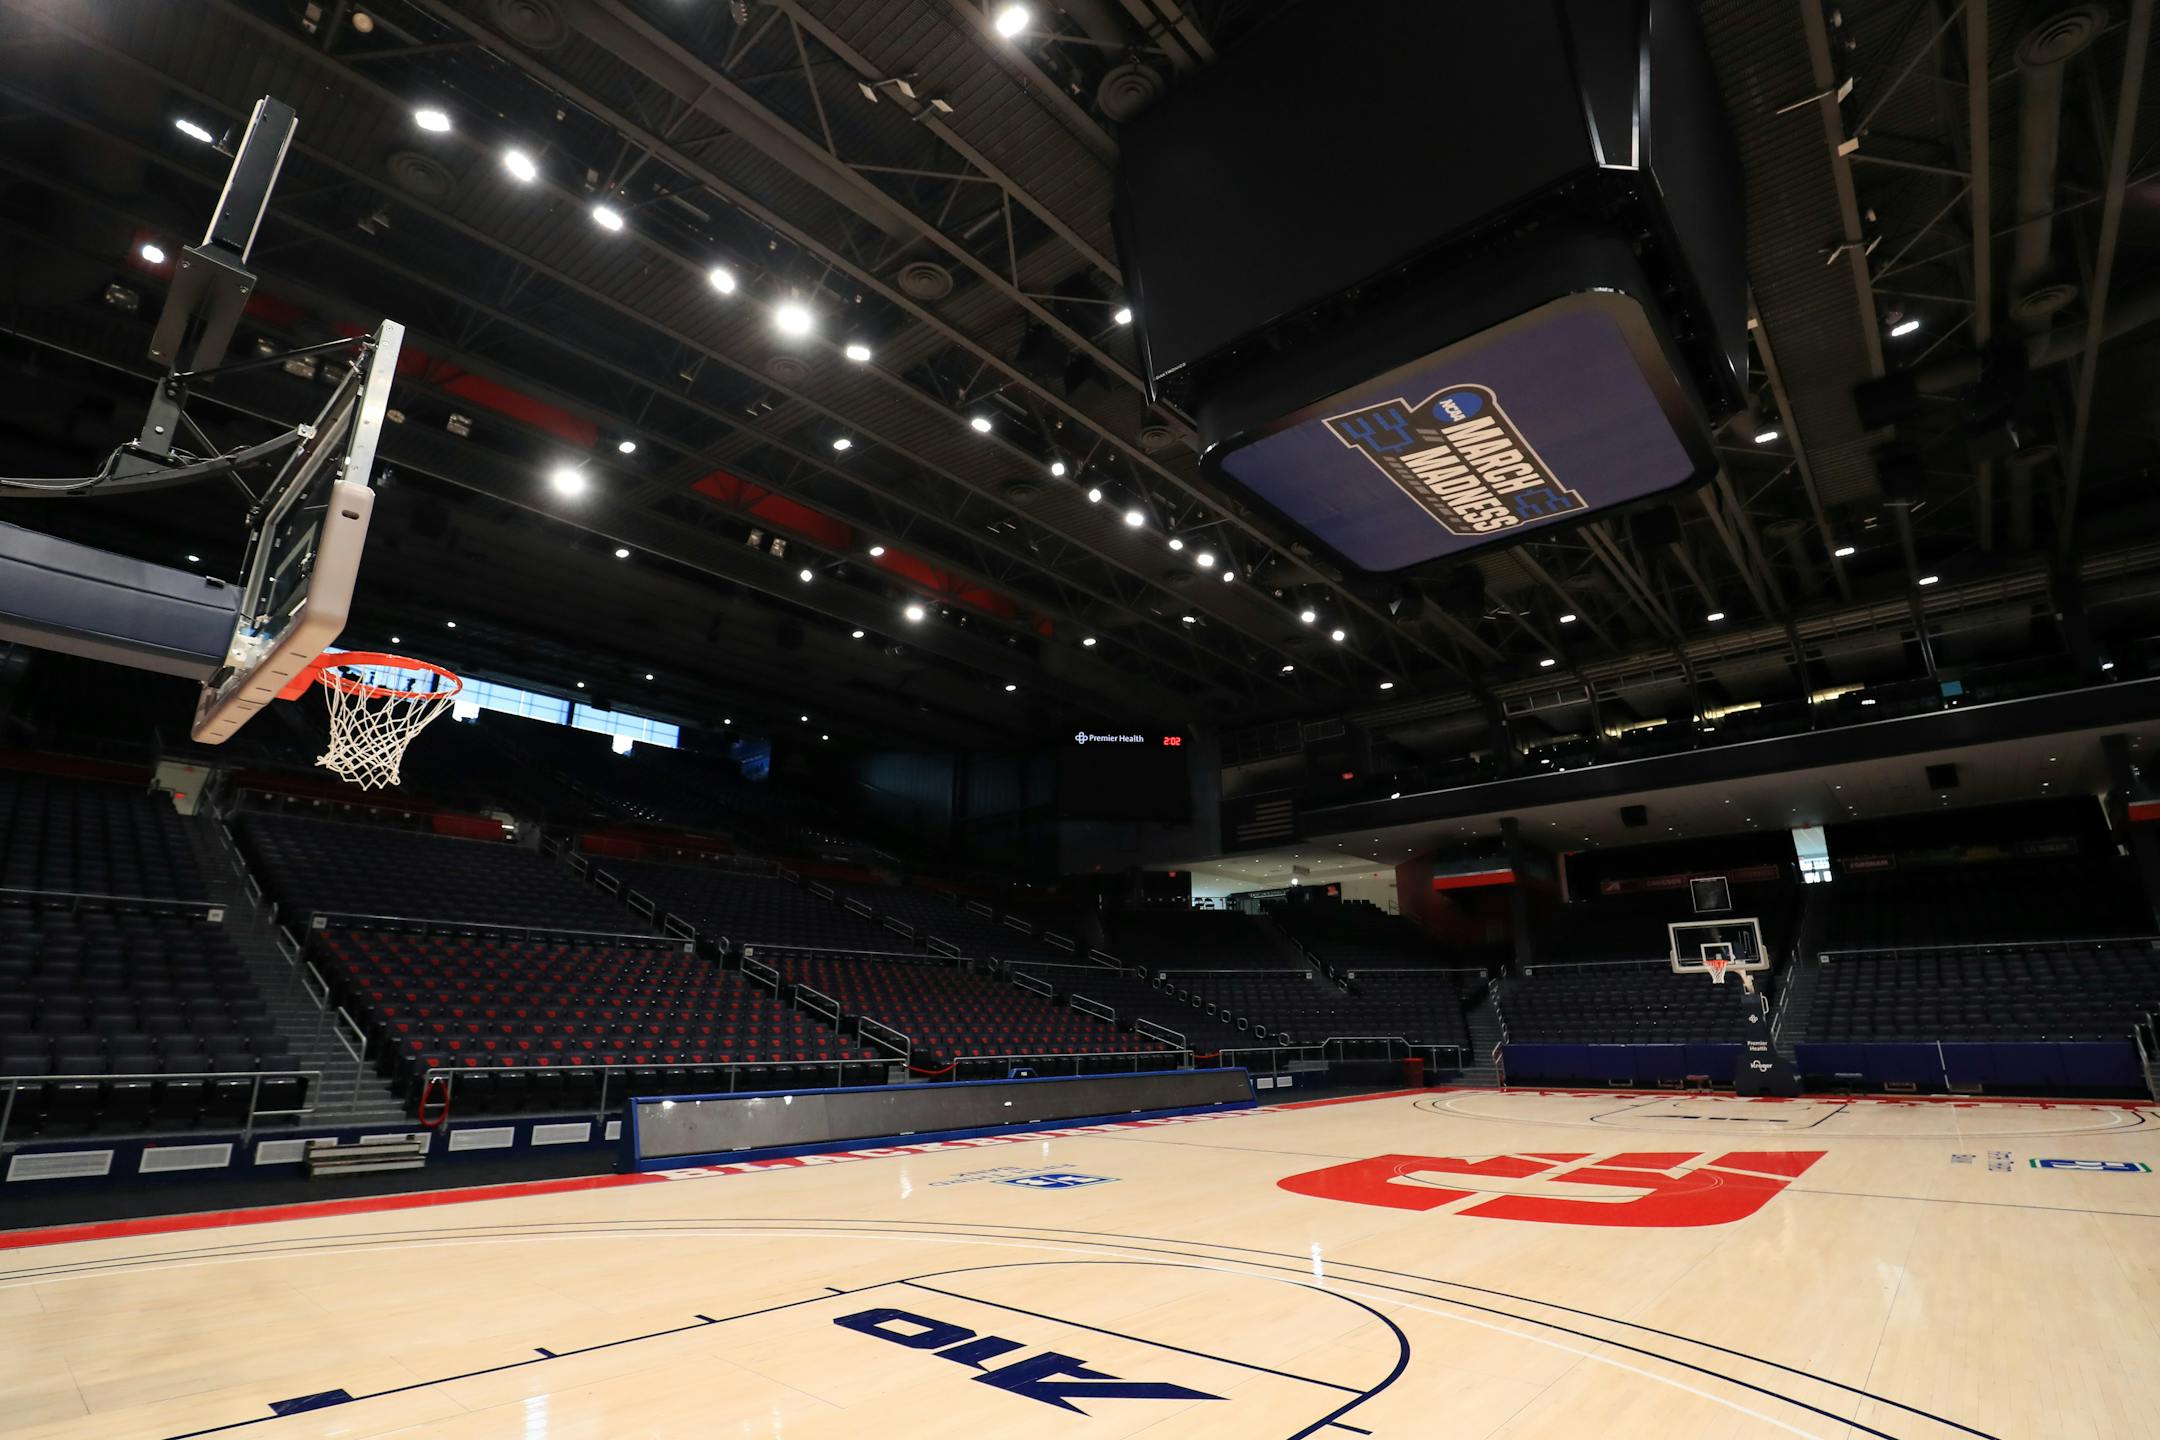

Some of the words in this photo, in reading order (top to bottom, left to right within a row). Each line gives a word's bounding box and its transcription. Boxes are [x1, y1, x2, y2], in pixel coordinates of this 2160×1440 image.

[1440, 398, 1467, 423] NCAA
[1440, 415, 1546, 494] MARCH
[1399, 444, 1520, 532] MADNESS
[1089, 734, 1118, 743] Premier
[1119, 735, 1144, 744] Health
[1749, 1059, 1773, 1073] Kroger
[643, 1123, 1138, 1182] BLACKBURN
